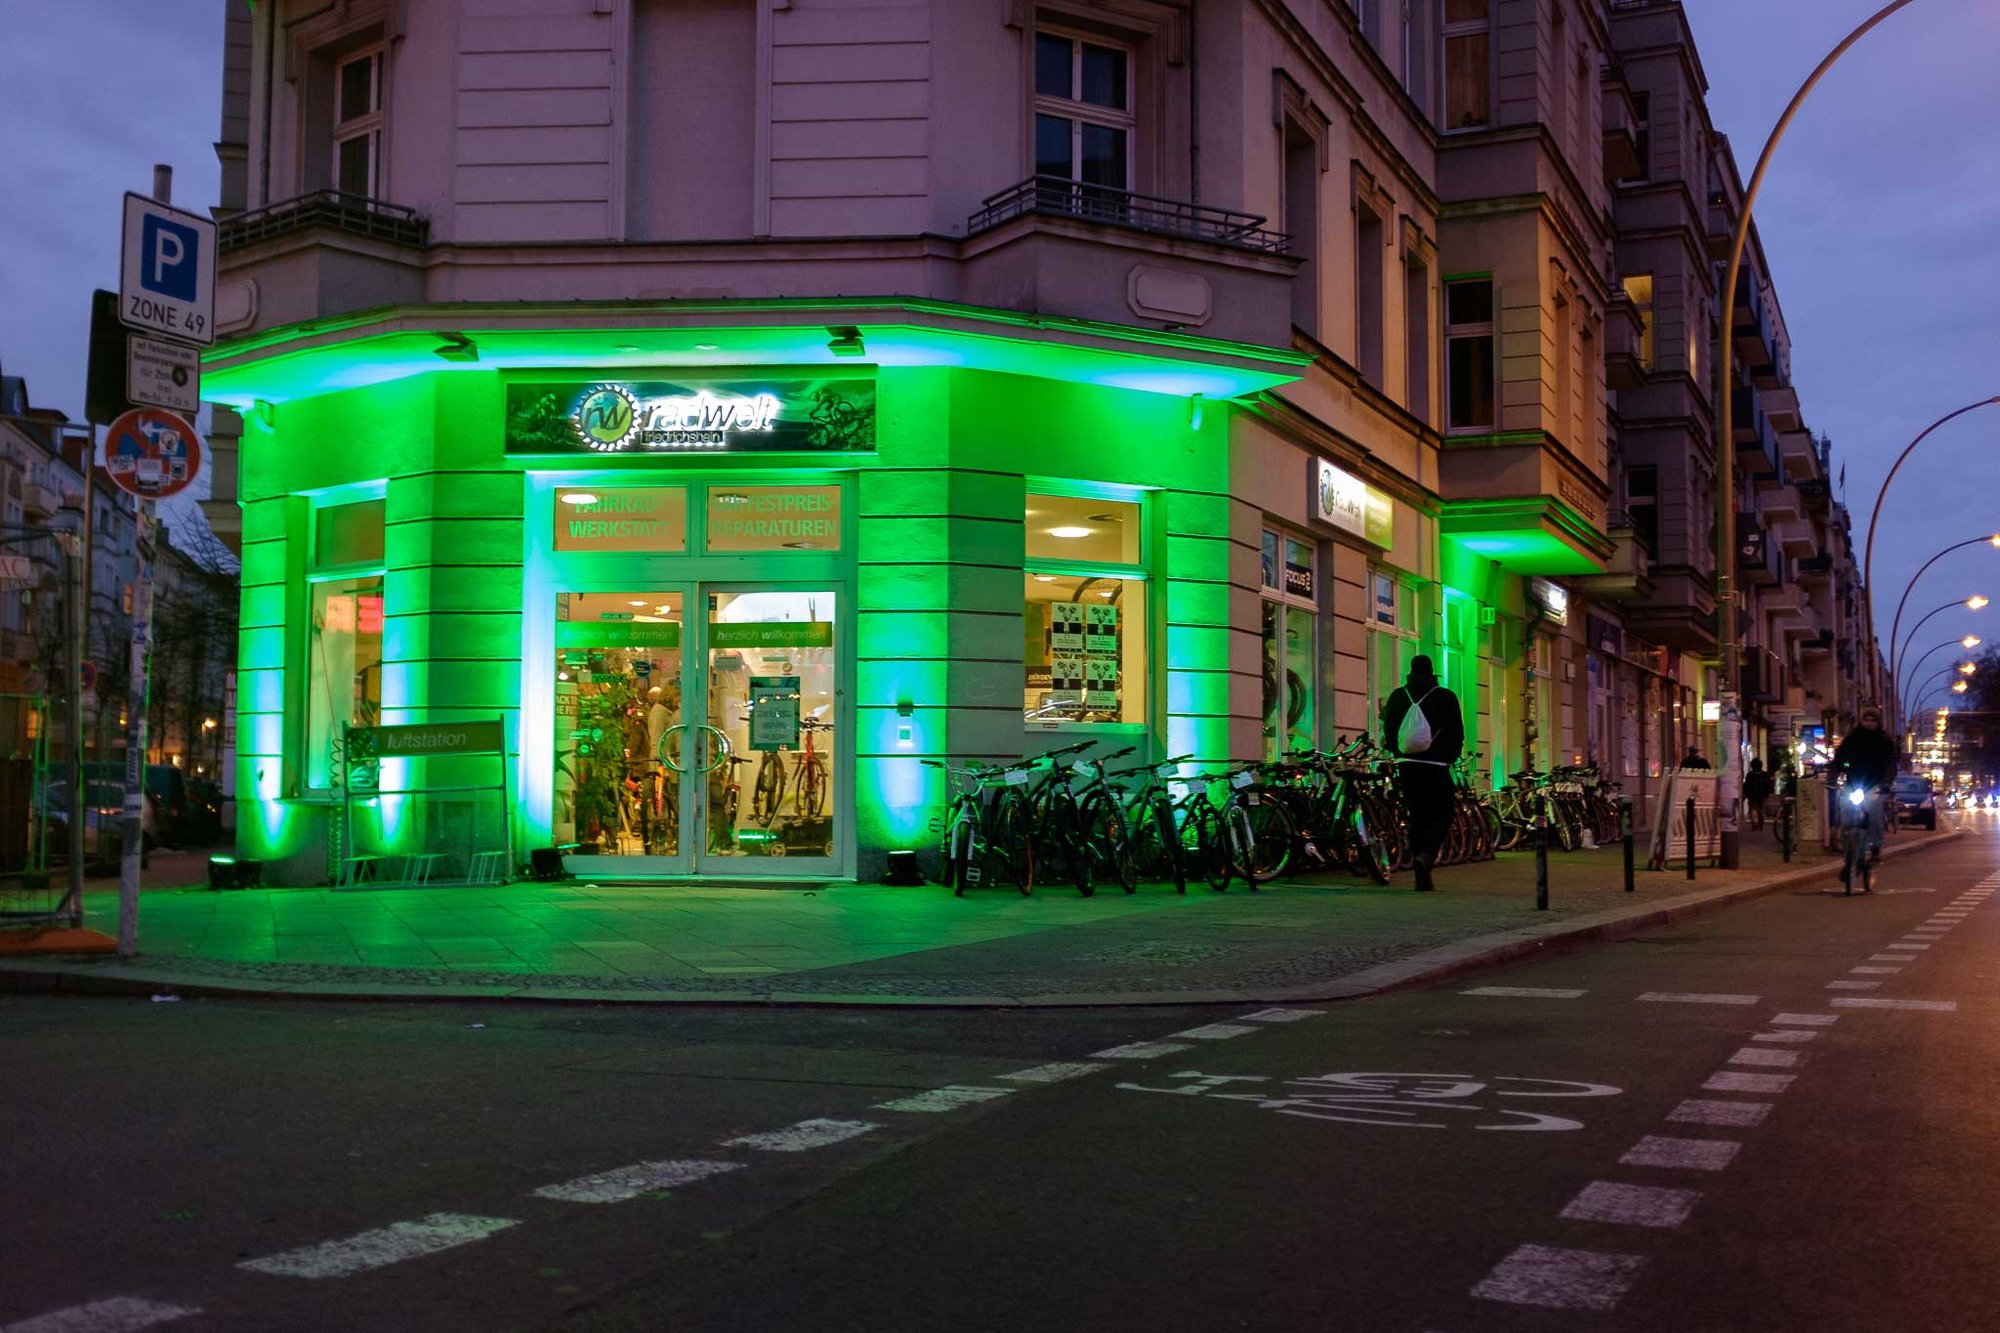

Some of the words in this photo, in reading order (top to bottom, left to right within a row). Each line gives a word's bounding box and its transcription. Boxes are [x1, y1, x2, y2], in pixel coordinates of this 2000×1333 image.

[154, 227, 184, 283] P
[131, 295, 177, 328] ZONE
[184, 311, 205, 334] 49
[645, 394, 776, 431] radwelt
[644, 431, 721, 445] friedrichshain
[569, 520, 671, 539] WERKSTATT
[712, 519, 837, 538] REPARATUREN
[716, 629, 759, 642] herzlich
[761, 628, 826, 642] willkommen
[387, 731, 467, 750] luftstation
